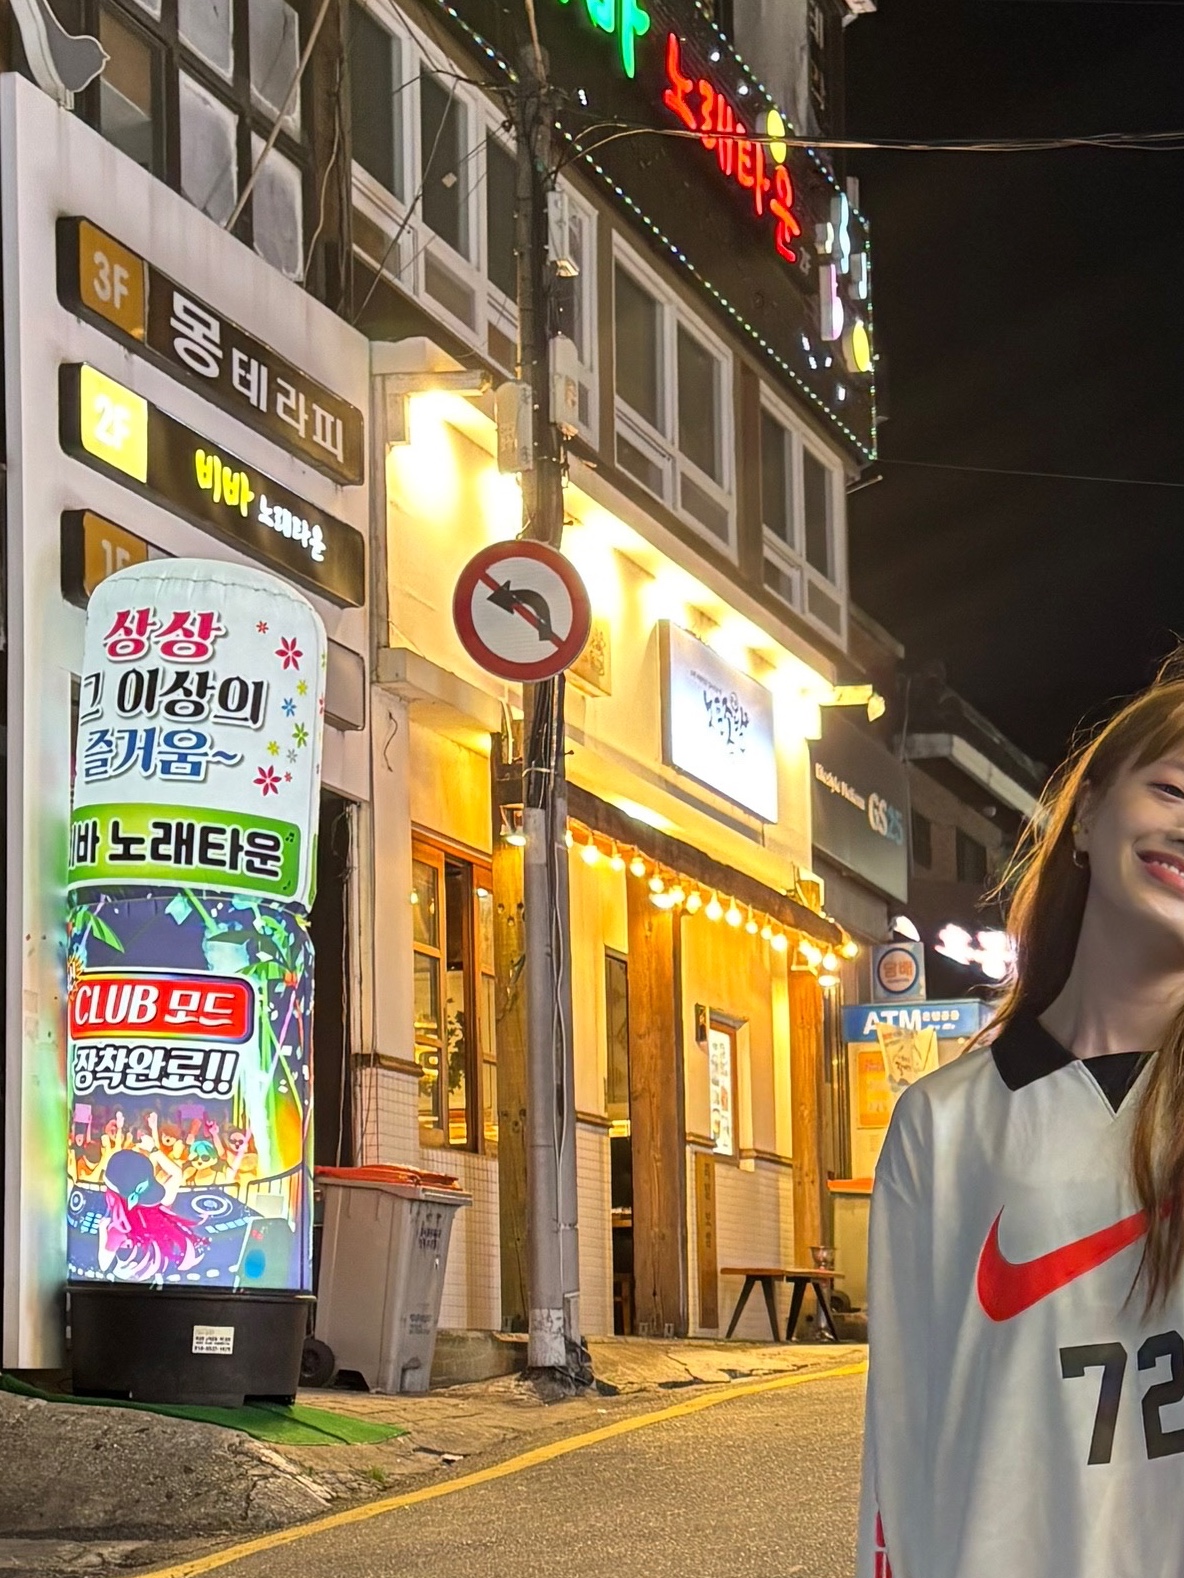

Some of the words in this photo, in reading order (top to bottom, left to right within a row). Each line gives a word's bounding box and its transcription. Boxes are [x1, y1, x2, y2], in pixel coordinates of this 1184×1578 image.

[93, 251, 130, 310] 3F
[93, 393, 132, 451] 2F
[195, 449, 255, 517] 비바
[258, 494, 327, 562] 노래타운
[103, 607, 224, 660] 상상
[116, 667, 266, 726] 이상의
[69, 819, 100, 870] 바
[108, 819, 282, 879] 노래타운
[74, 985, 160, 1026] CLUB
[164, 989, 236, 1026] 모드
[863, 1009, 922, 1035] ATM
[75, 1047, 238, 1095] 장착완료!!
